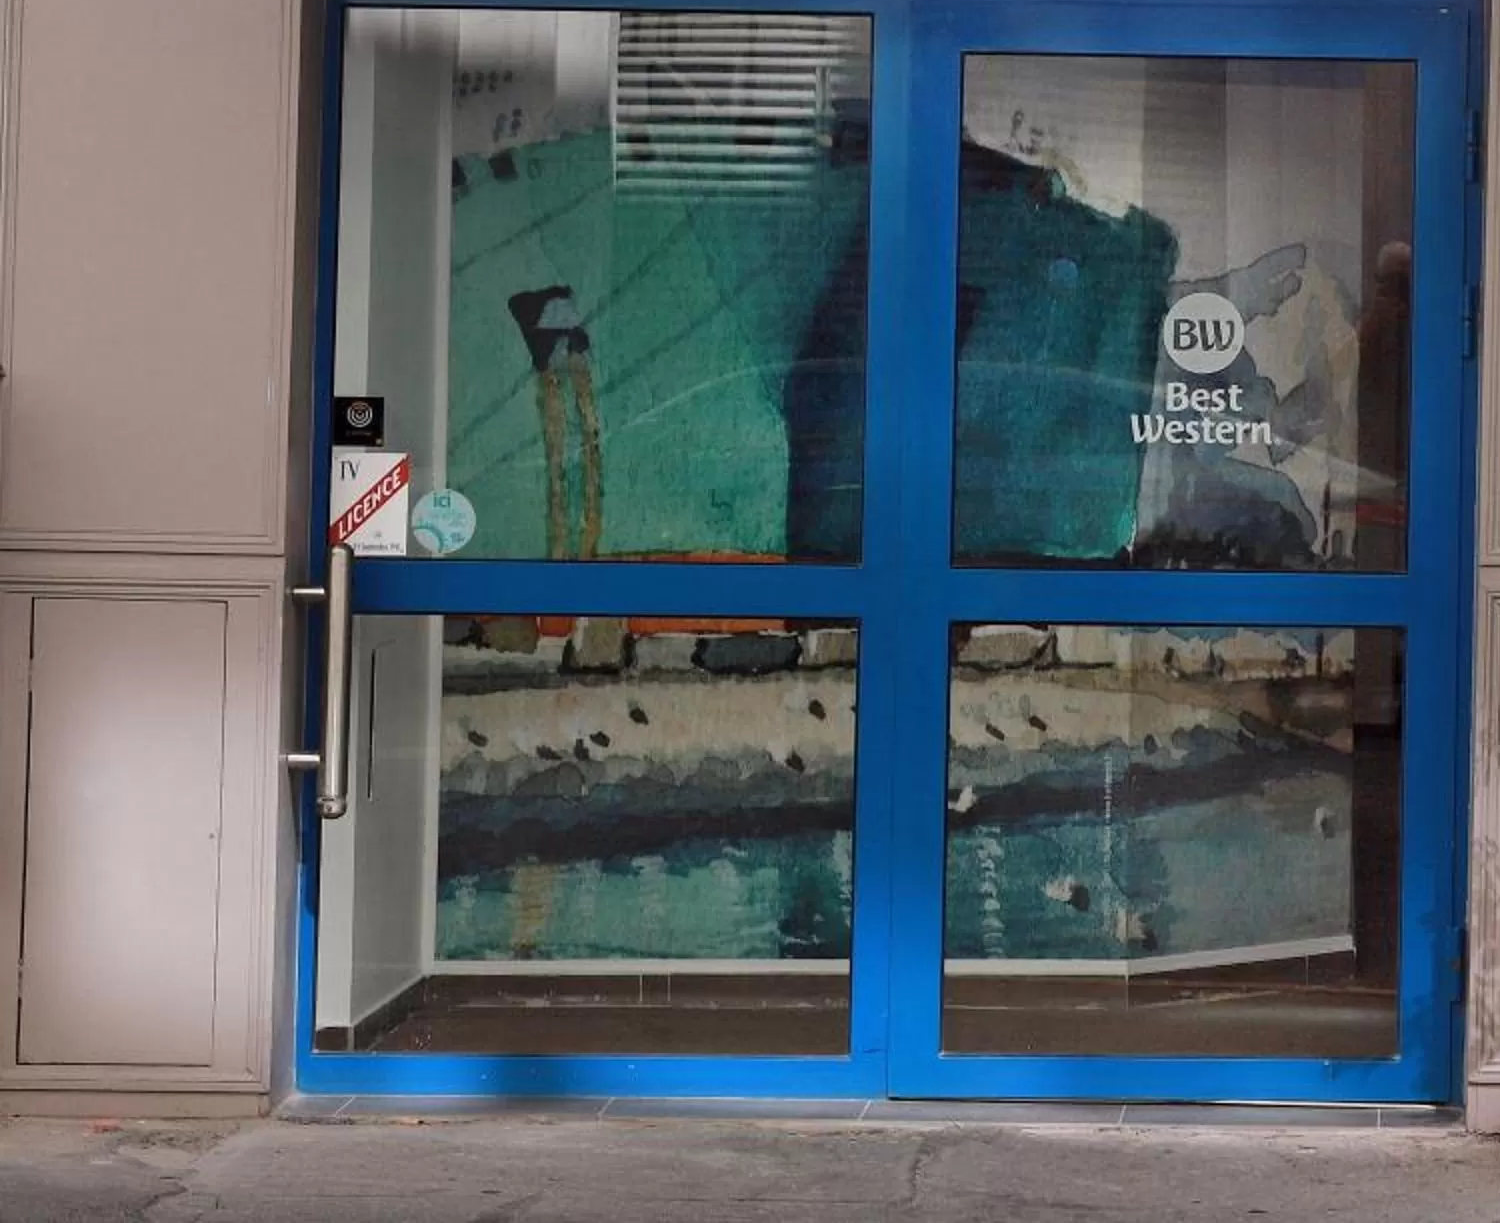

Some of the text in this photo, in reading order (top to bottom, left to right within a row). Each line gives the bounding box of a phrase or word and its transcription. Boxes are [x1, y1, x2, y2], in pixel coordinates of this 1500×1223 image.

[1173, 318, 1235, 352] BW
[1165, 382, 1243, 412] Best
[1130, 414, 1272, 445] Western
[338, 467, 402, 539] LICENCE
